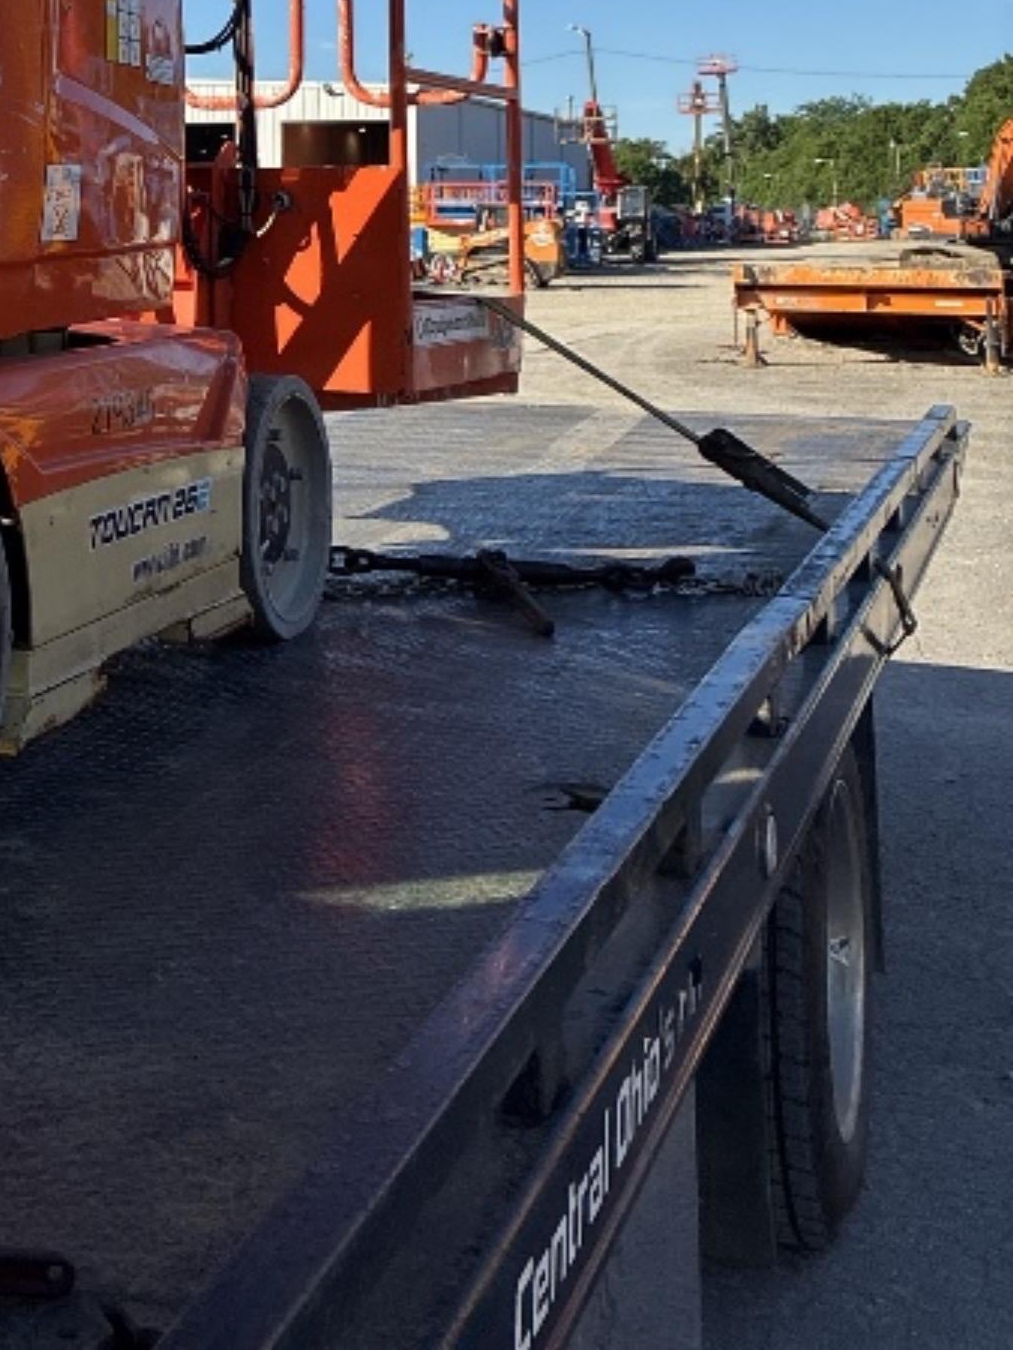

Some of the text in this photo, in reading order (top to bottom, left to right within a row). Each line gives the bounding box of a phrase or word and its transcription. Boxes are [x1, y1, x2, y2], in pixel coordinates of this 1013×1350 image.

[91, 495, 170, 550] TOUCAN
[514, 1035, 662, 1350] Central Ohio
